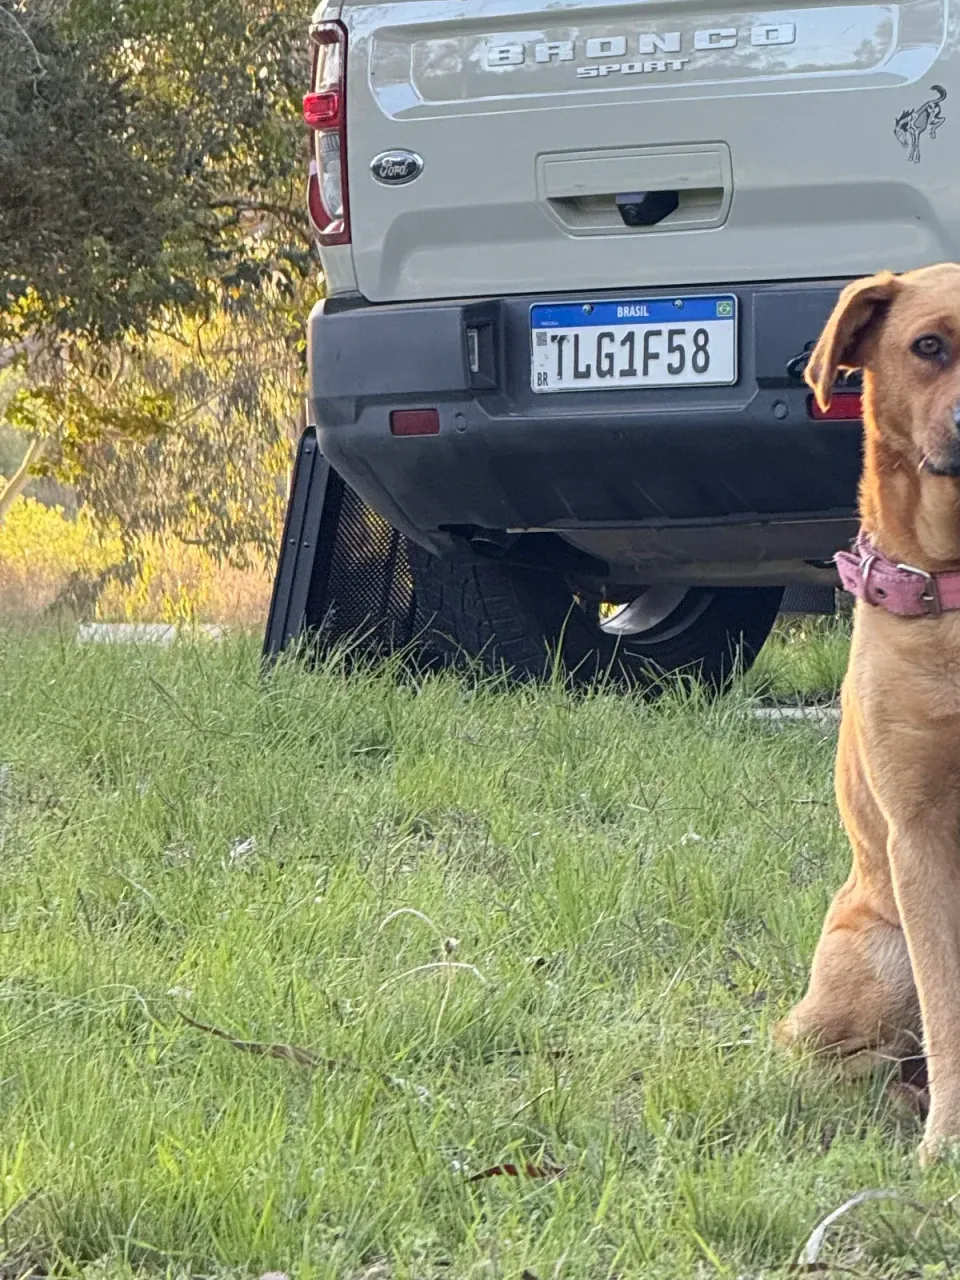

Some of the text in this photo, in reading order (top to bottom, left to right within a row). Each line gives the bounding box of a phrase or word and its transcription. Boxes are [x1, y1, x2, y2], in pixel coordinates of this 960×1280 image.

[487, 23, 797, 67] BRONCO
[576, 58, 690, 78] SPORT
[380, 158, 413, 177] Ford
[617, 306, 650, 318] BRASIL
[550, 328, 710, 380] TLG1F58
[537, 371, 549, 387] BR
